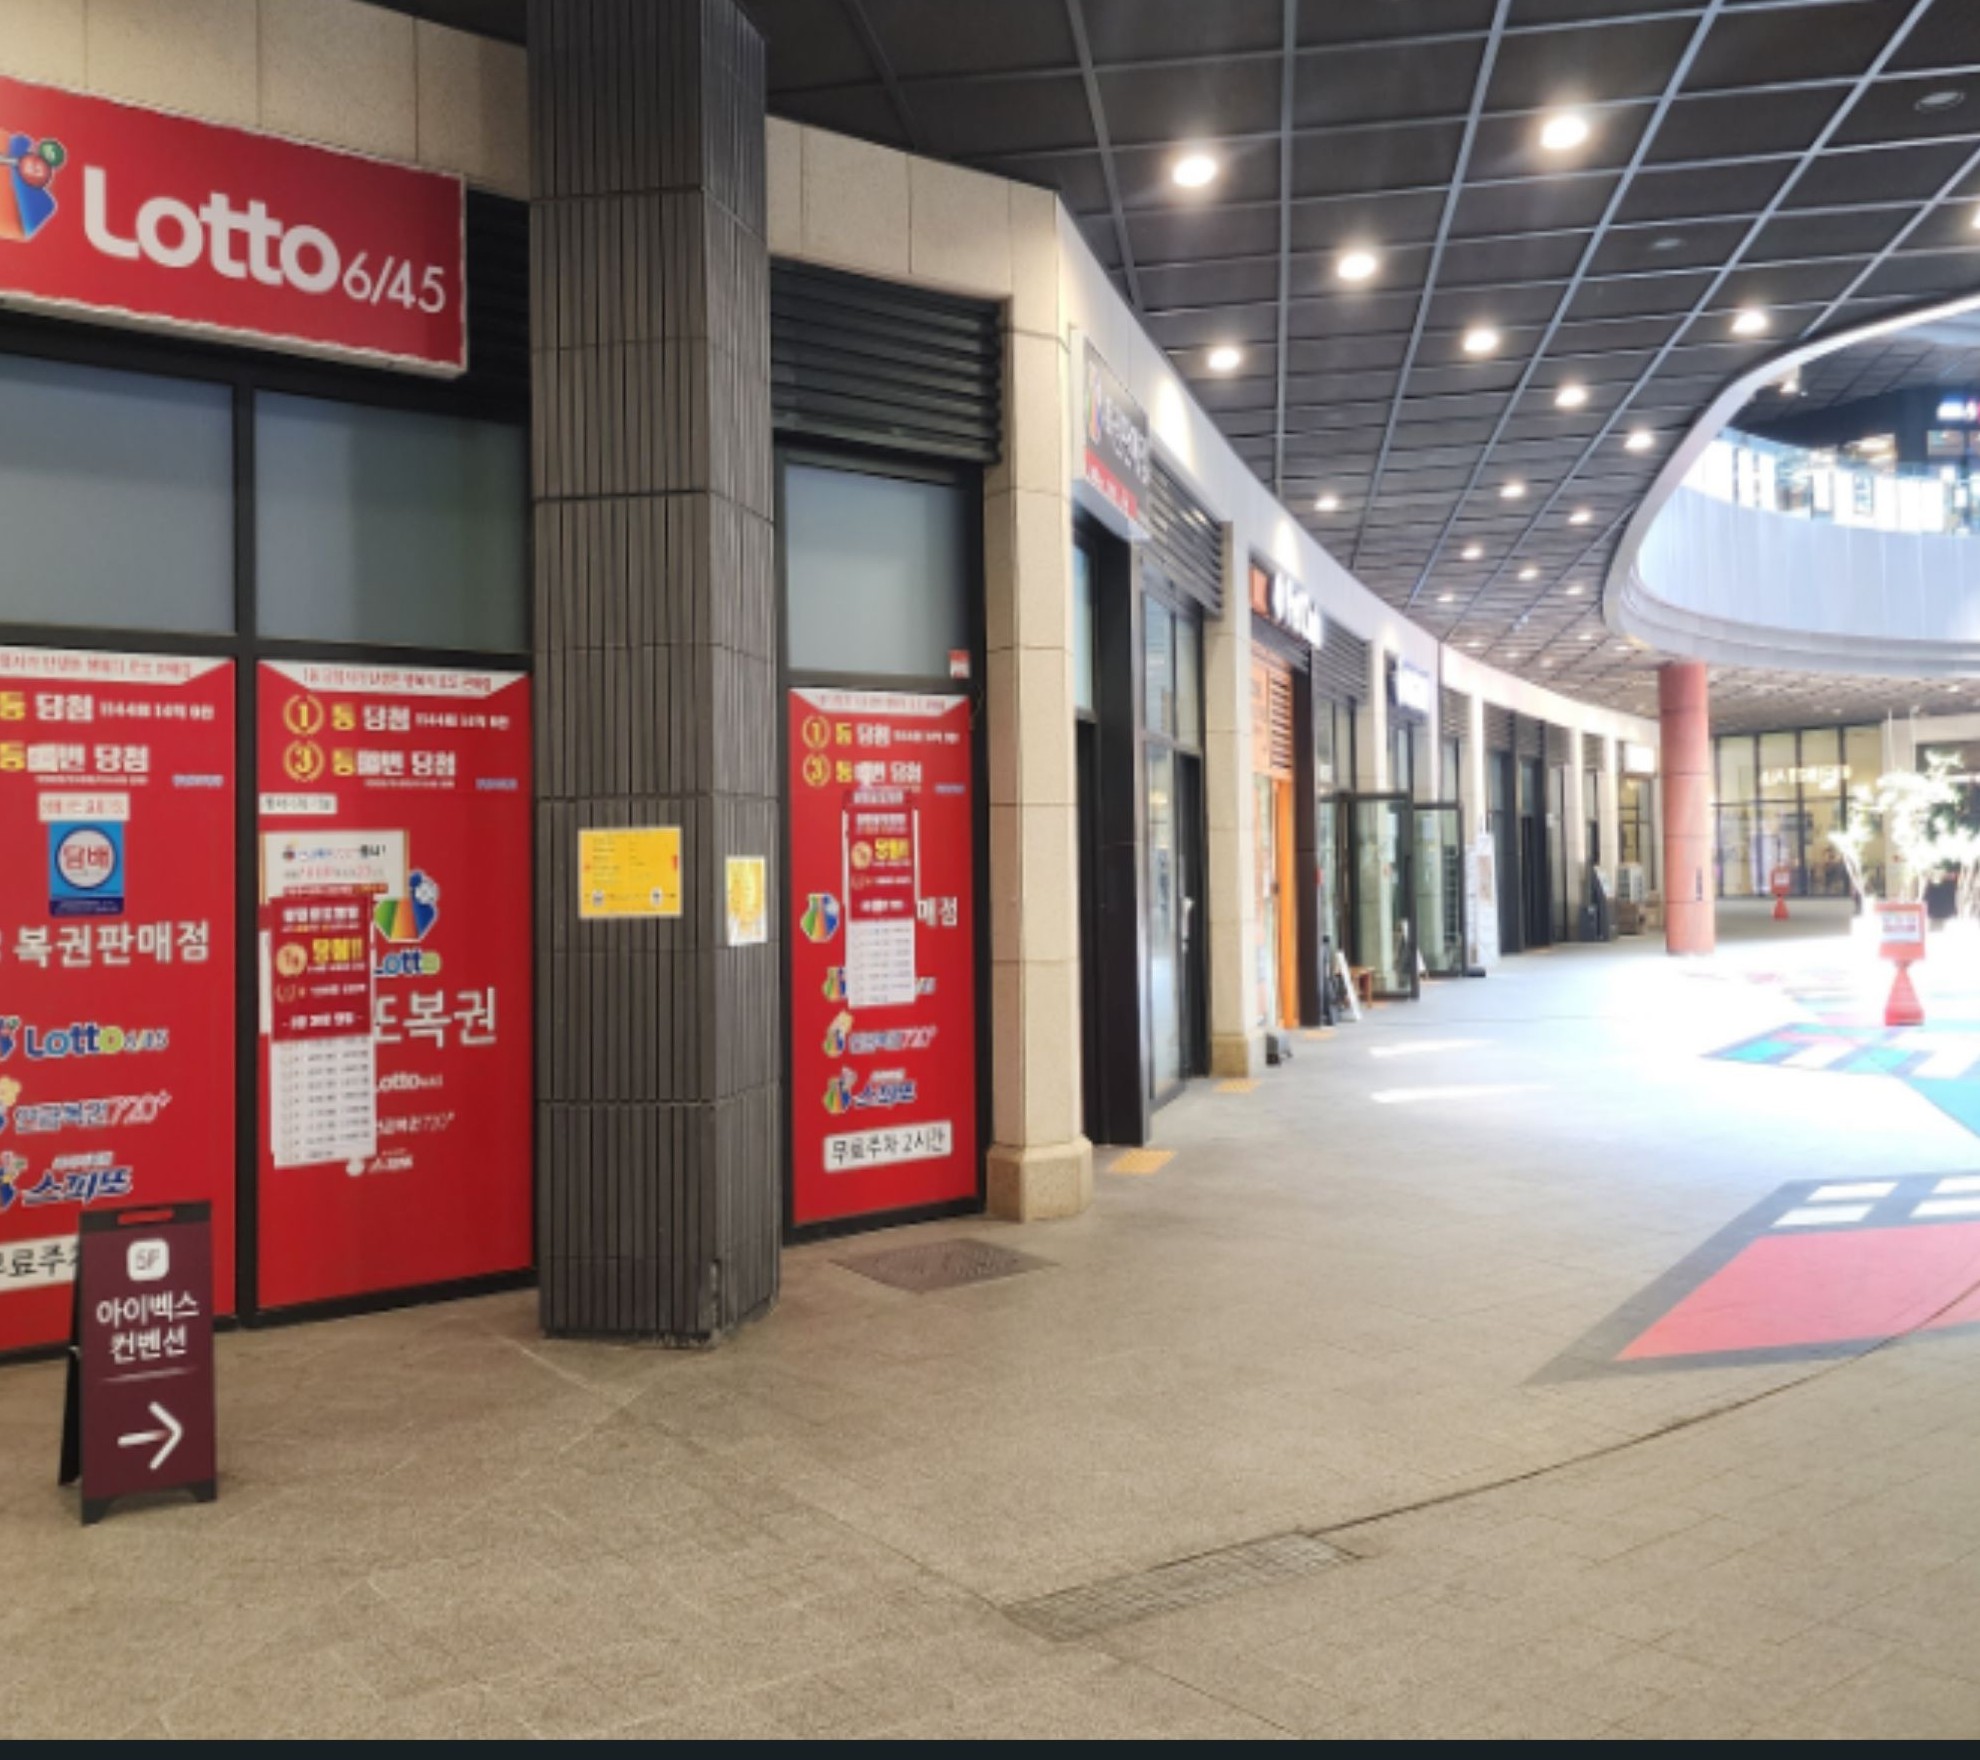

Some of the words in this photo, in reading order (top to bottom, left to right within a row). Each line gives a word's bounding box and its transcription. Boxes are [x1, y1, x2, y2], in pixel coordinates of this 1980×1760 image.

[83, 165, 341, 294] Lotto
[341, 250, 446, 314] 6/45
[62, 845, 110, 871] 담배
[14, 920, 209, 968] 복권판매점
[24, 1023, 123, 1059] Lotto
